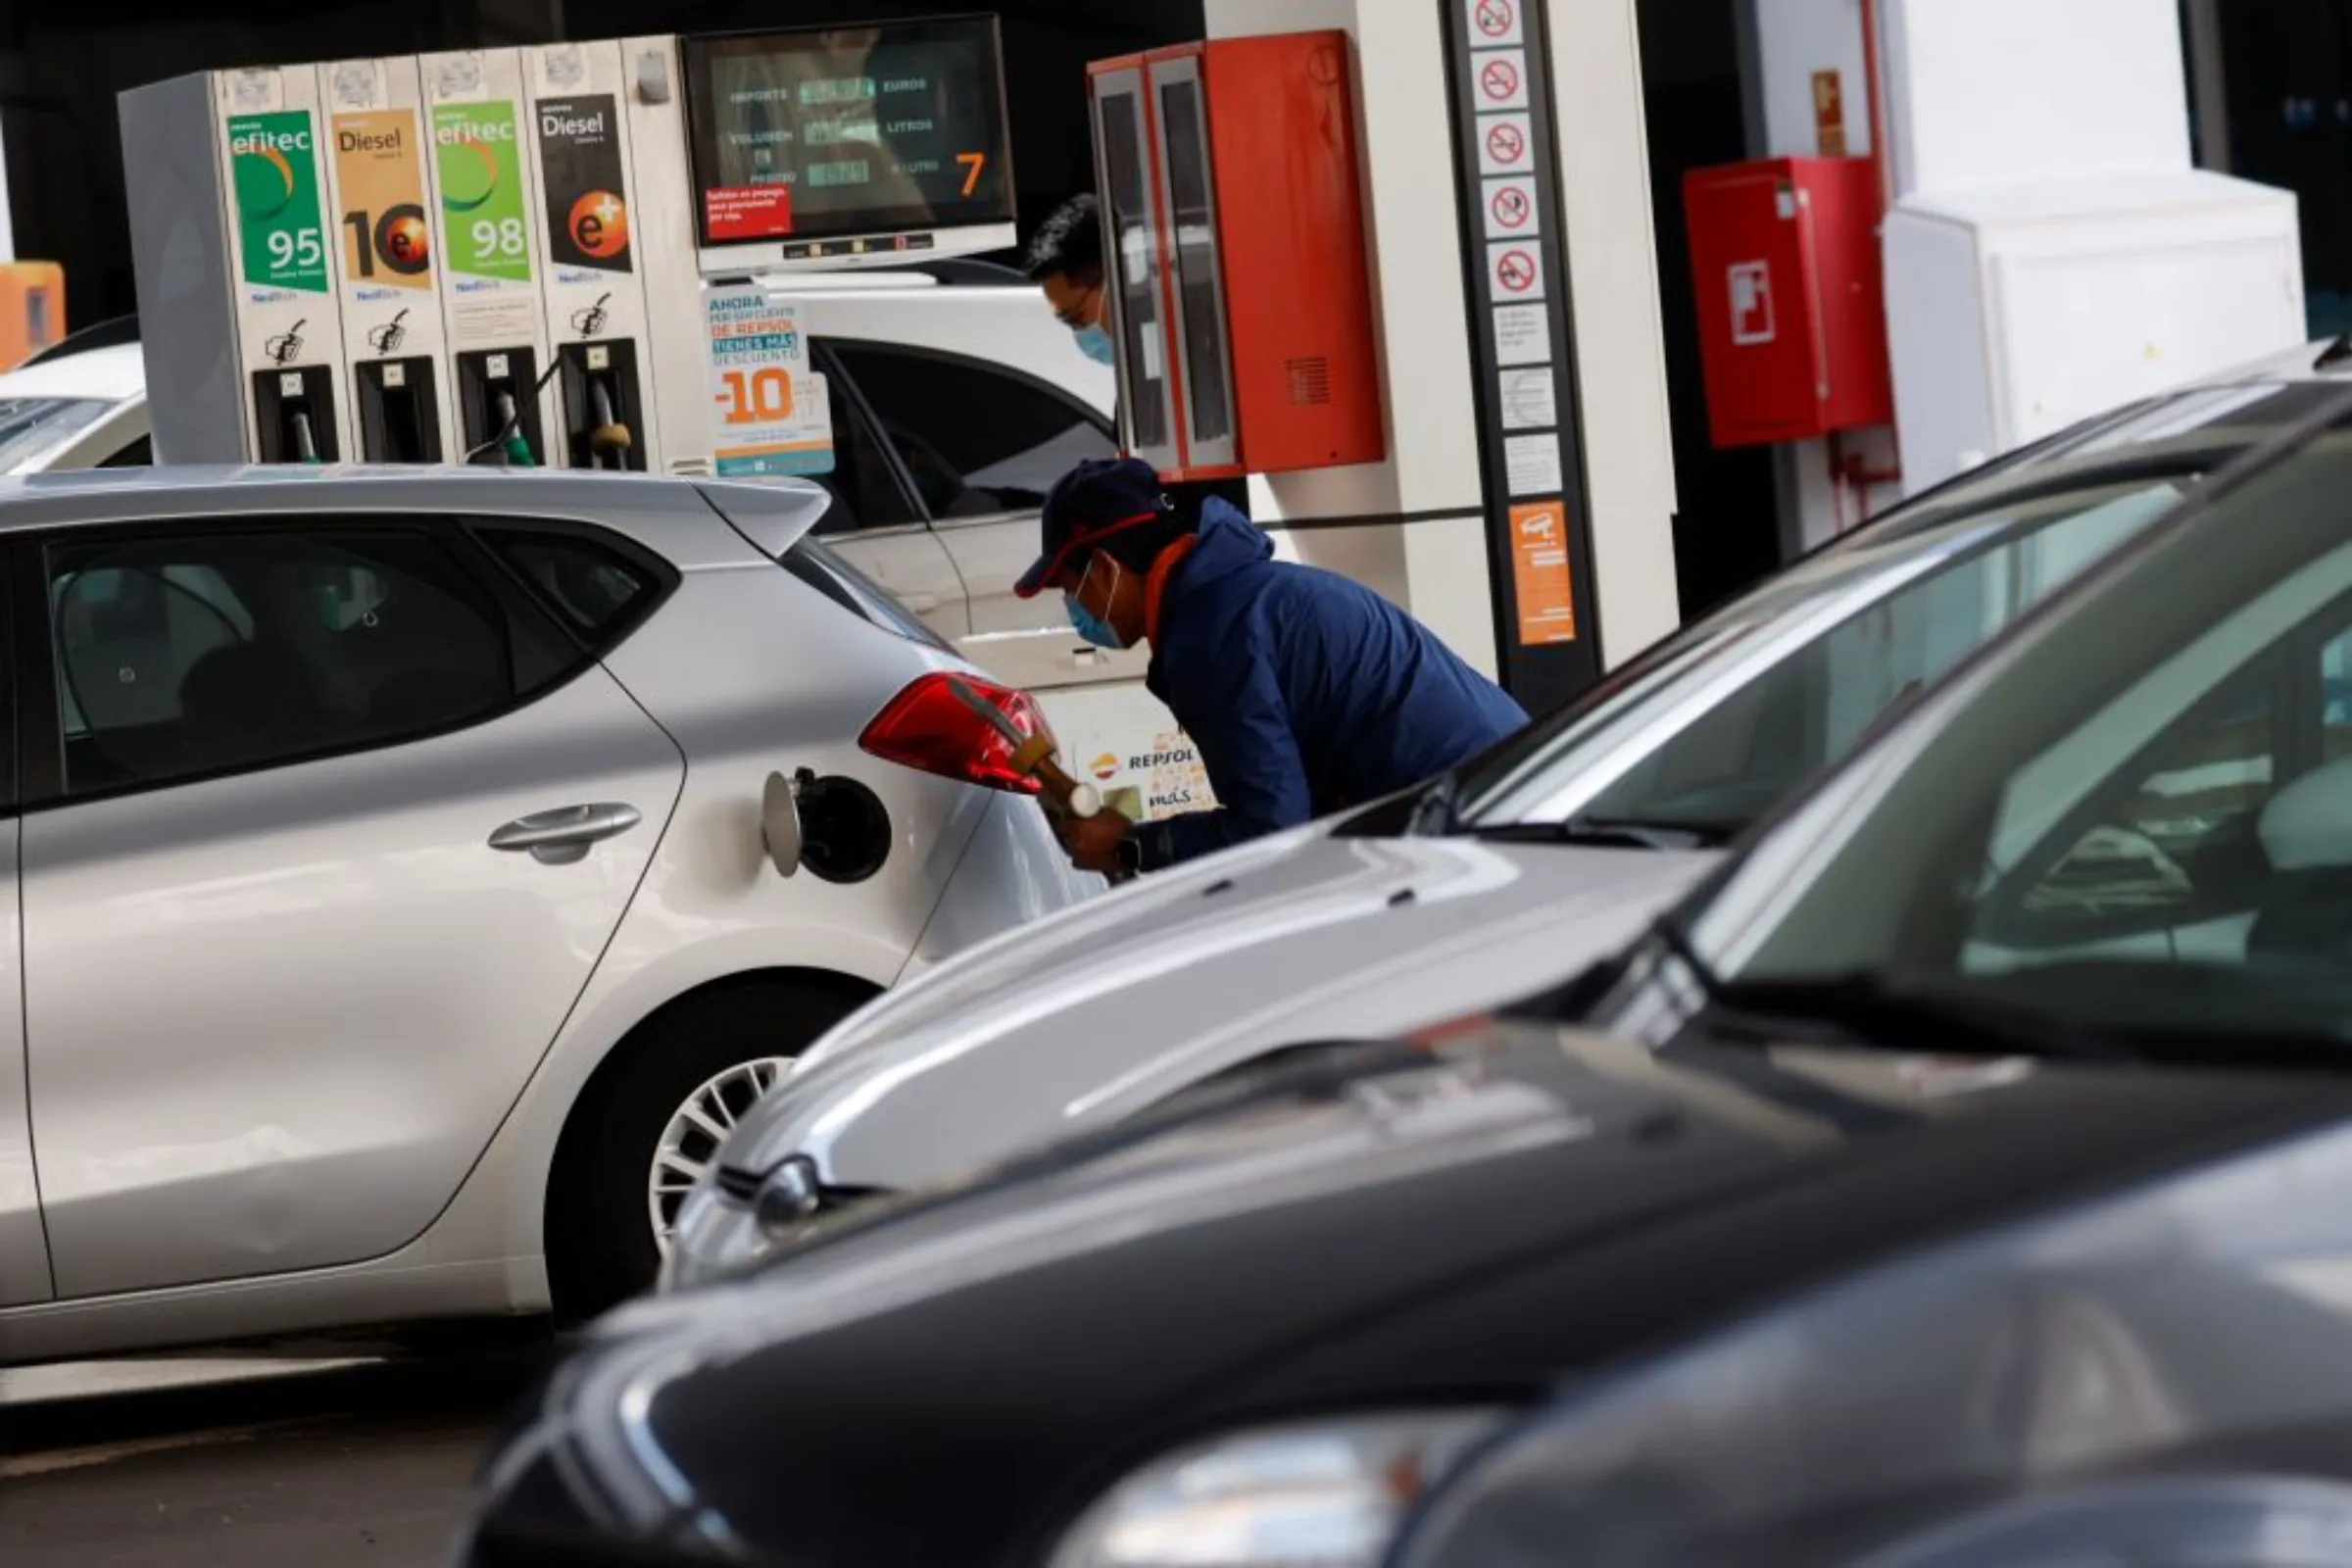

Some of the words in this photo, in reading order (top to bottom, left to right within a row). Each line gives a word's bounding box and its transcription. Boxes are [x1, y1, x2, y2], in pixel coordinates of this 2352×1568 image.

[884, 78, 927, 92] EUROS
[436, 121, 514, 146] efitec
[542, 112, 604, 137] Diesel
[886, 119, 933, 133] LITROS
[232, 130, 310, 155] efitec
[338, 127, 401, 151] Diesel
[956, 152, 986, 197] 7
[267, 226, 321, 270] 95
[471, 217, 525, 259] 98
[710, 296, 764, 311] AHORA
[1129, 749, 1193, 769] REPSOL
[1149, 784, 1191, 808] más
